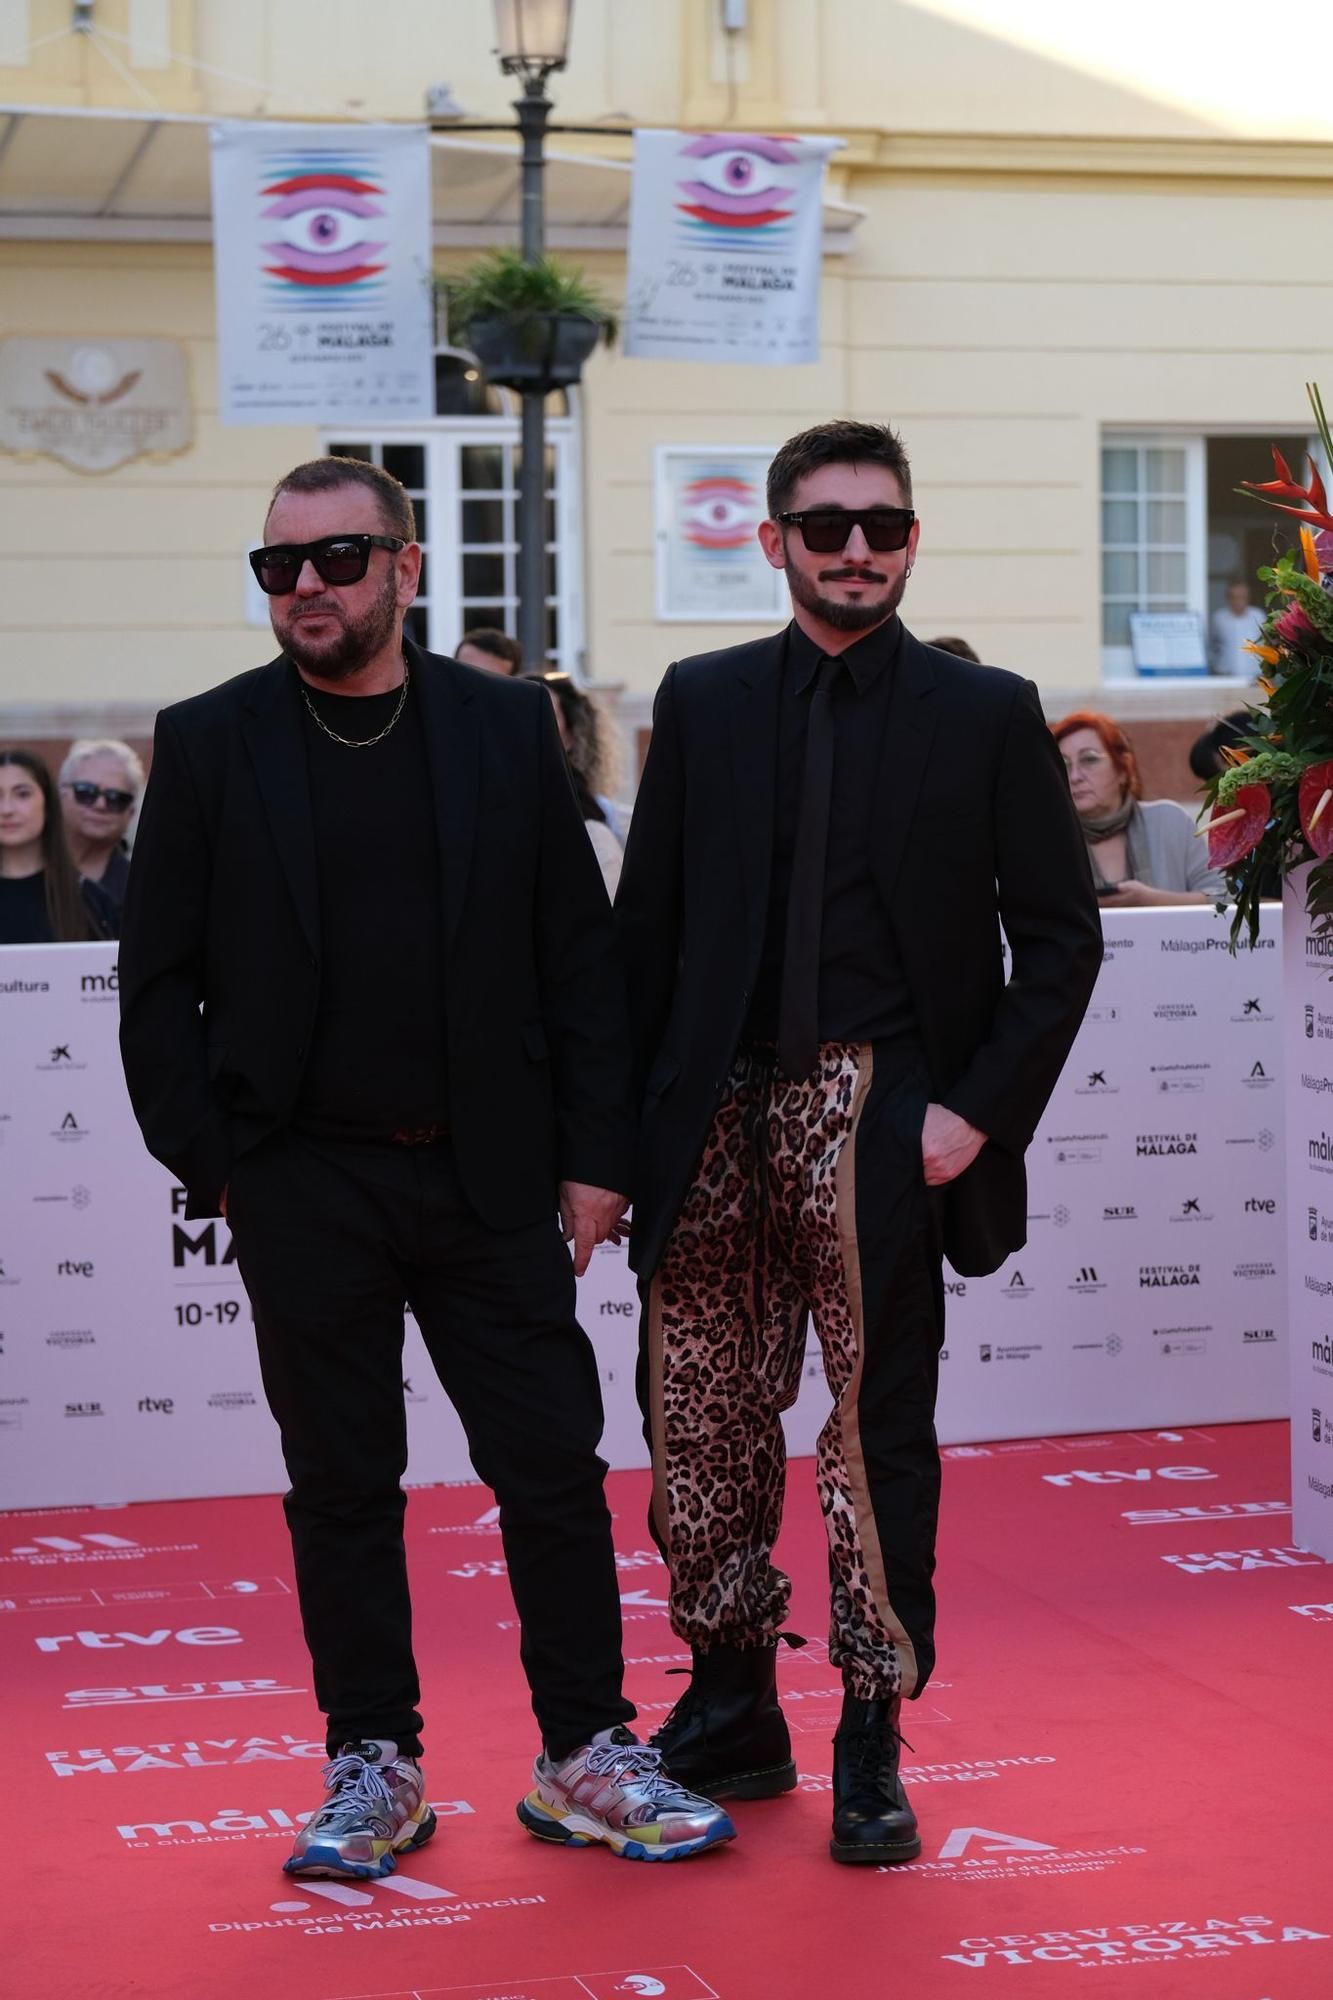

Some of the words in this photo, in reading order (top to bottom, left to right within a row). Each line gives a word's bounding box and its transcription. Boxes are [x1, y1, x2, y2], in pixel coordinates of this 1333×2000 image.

[1153, 1010, 1197, 1018] VICTORIA
[1136, 1134, 1180, 1143] FESTIVAL
[1185, 1133, 1197, 1142] DE
[1103, 1207, 1136, 1215] SUR
[1244, 1198, 1276, 1214] rtve
[58, 1261, 94, 1277] rtve
[1140, 1266, 1184, 1275] FESTIVAL
[1188, 1264, 1200, 1273] DE
[1233, 1269, 1276, 1277] VICTORIA
[174, 1301, 240, 1326] 10-19
[600, 1301, 634, 1317] rtve
[1243, 1330, 1274, 1339] SUR
[65, 1402, 101, 1412] SUR
[138, 1396, 174, 1414] rtve
[1042, 1466, 1219, 1487] rtve
[1120, 1500, 1290, 1521] SUR
[35, 1626, 243, 1652] rtve
[64, 1678, 292, 1702] SUR
[45, 1734, 309, 1762] FESTIVAL
[158, 1833, 247, 1846] ciudad
[875, 1861, 955, 1874] Junta
[963, 1858, 998, 1868] de
[1006, 1845, 1148, 1865] Andalucía
[951, 1871, 1016, 1882] Cultura
[1033, 1865, 1106, 1876] Deporte
[207, 1910, 383, 1934] Diputación
[391, 1894, 546, 1918] Provincial
[304, 1923, 345, 1935] de
[354, 1914, 472, 1932] Málaga
[959, 1914, 1275, 1949] CERVEZAS
[940, 1925, 1332, 1968] VICTORIA
